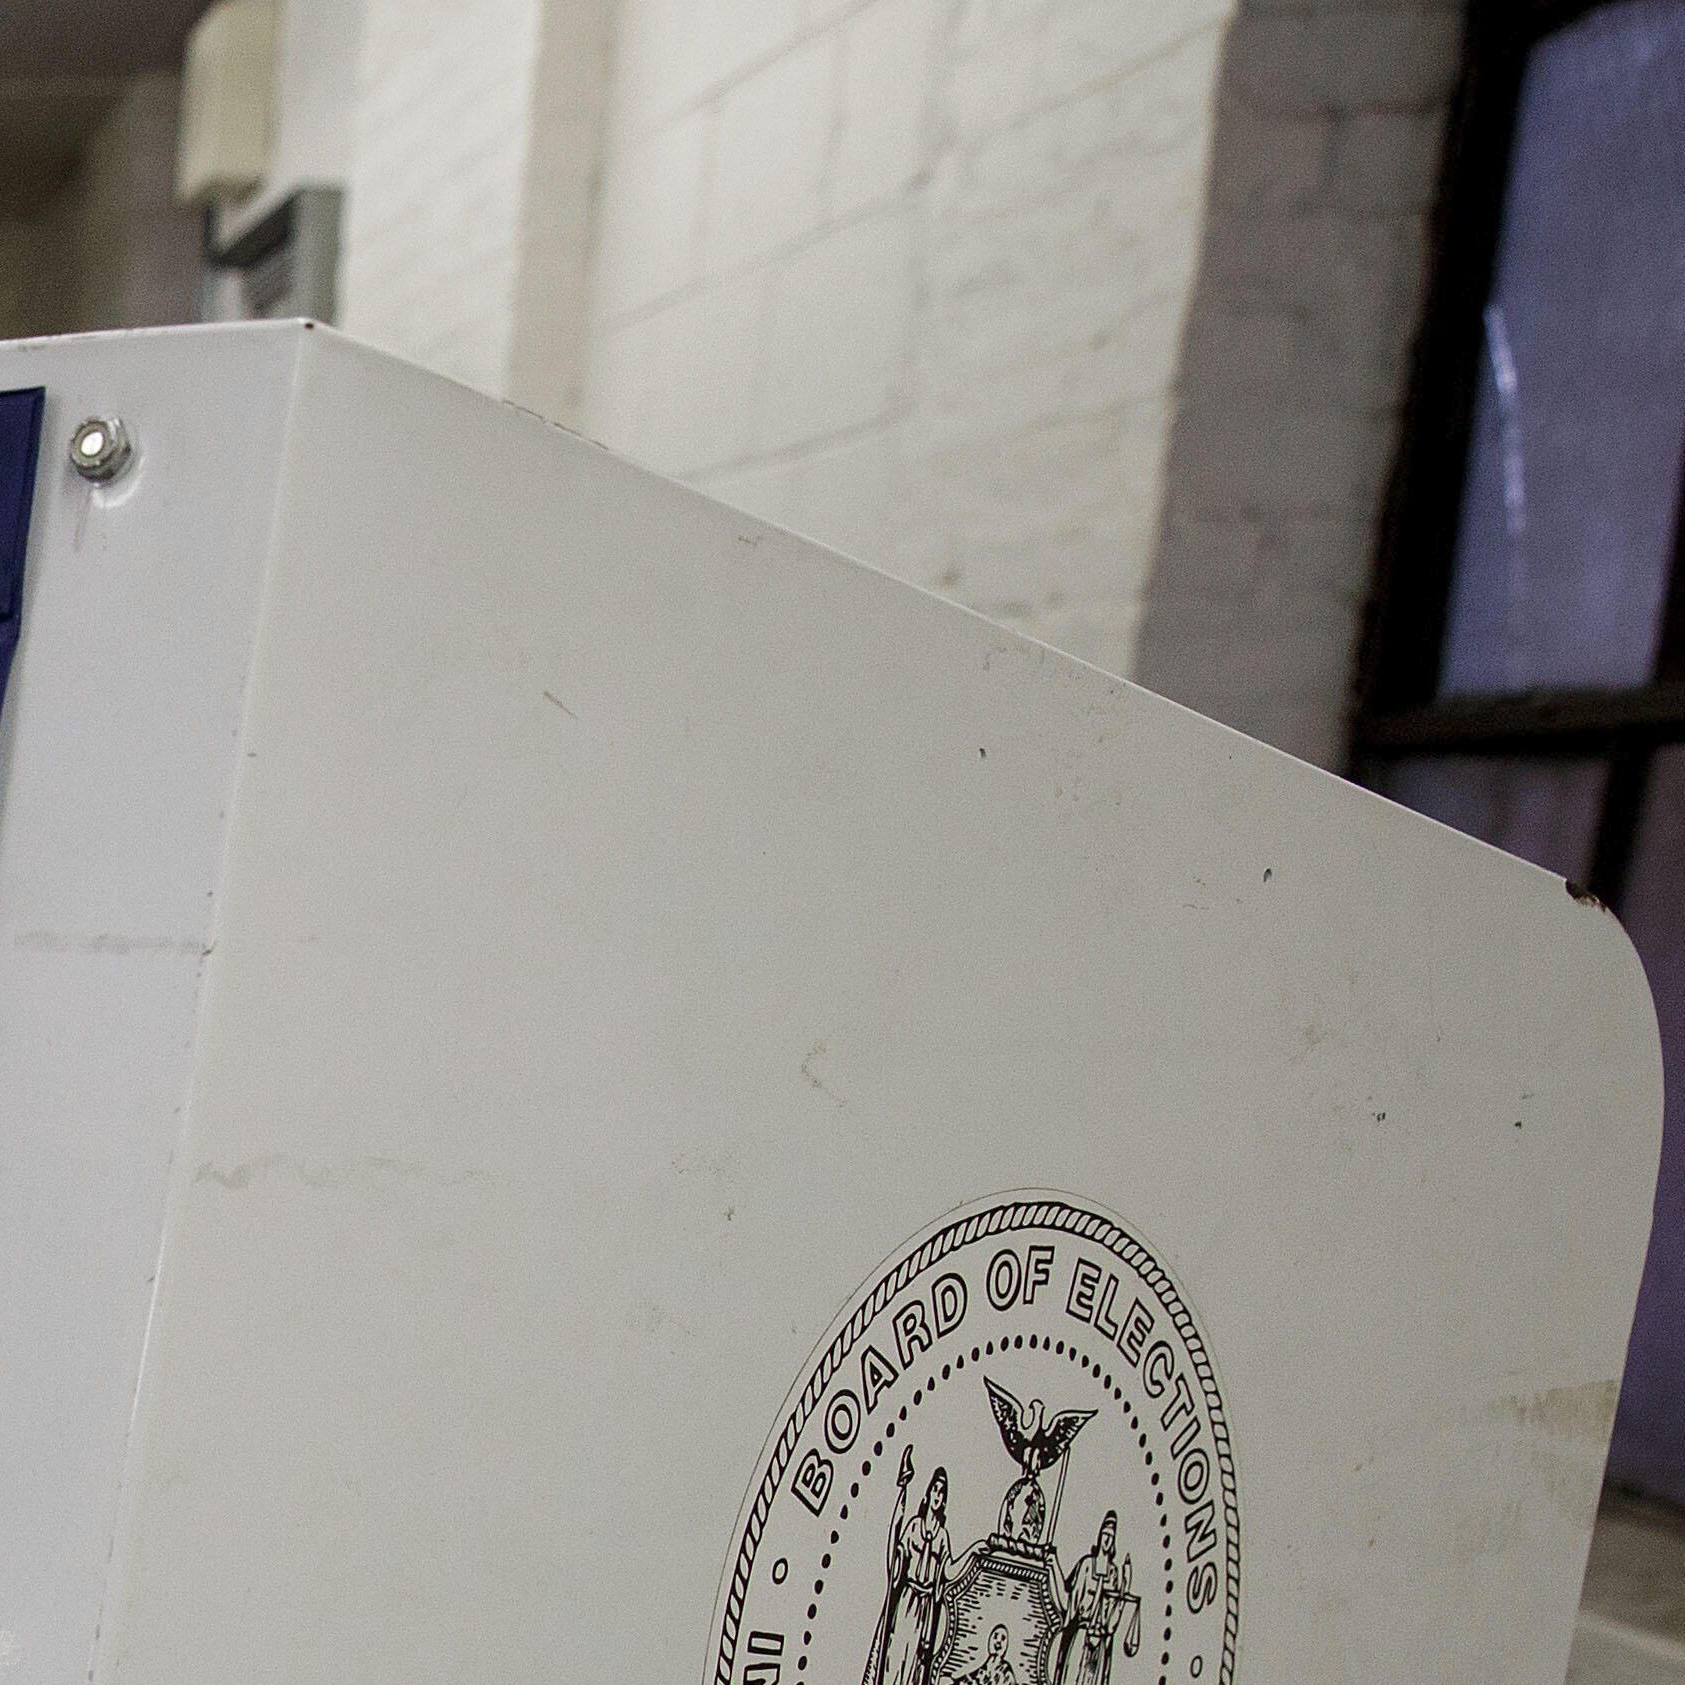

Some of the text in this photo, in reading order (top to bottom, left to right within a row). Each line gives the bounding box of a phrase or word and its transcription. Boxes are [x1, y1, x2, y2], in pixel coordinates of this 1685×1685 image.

[790, 1245, 1218, 1614] BOARD OF ELECTIONS
